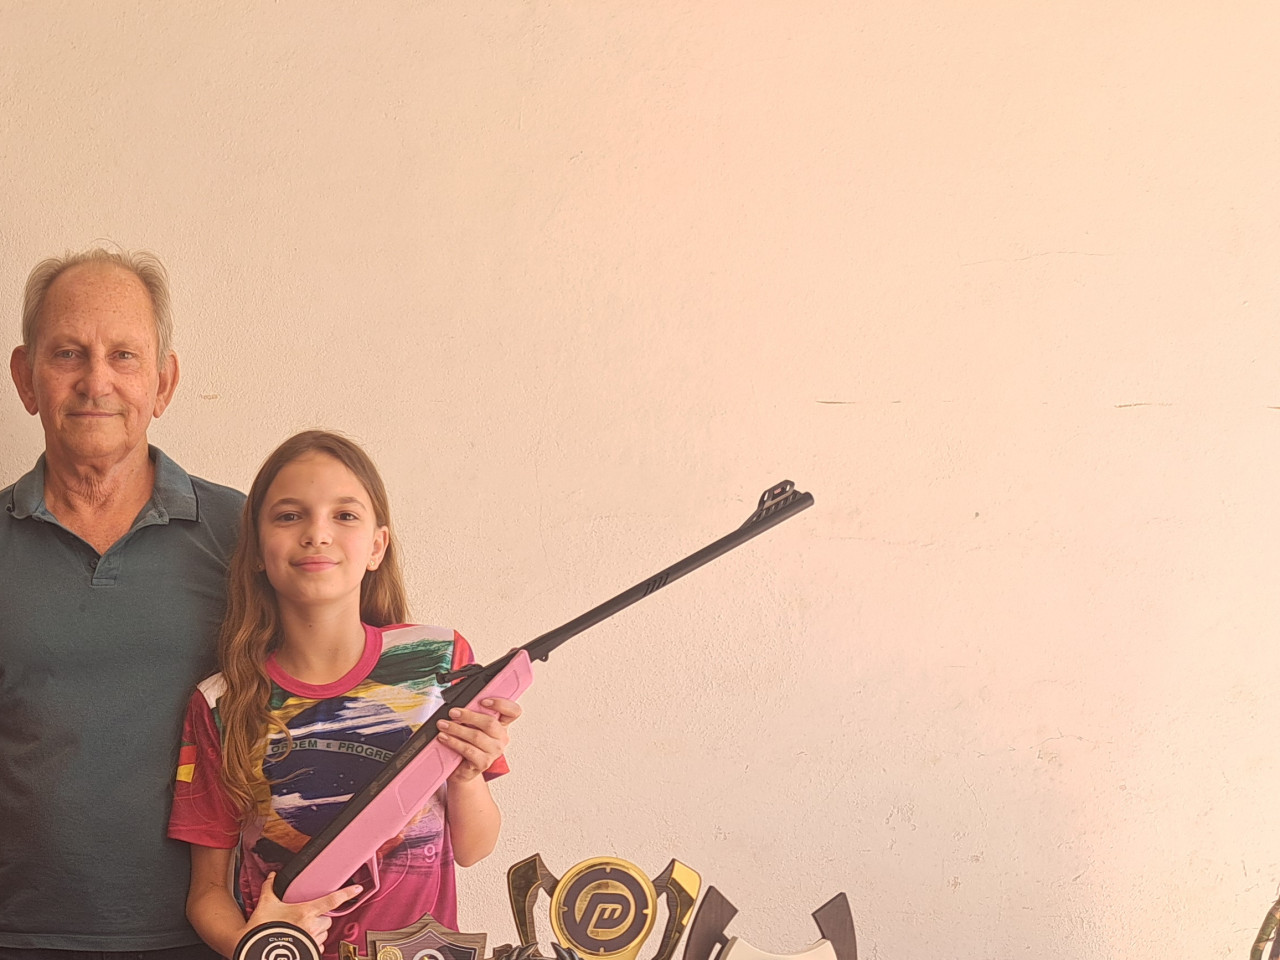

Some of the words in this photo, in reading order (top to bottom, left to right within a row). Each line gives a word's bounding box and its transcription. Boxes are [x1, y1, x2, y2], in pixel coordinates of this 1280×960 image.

[271, 740, 318, 753] ORDEM
[424, 844, 436, 863] 9
[344, 921, 359, 941] 9
